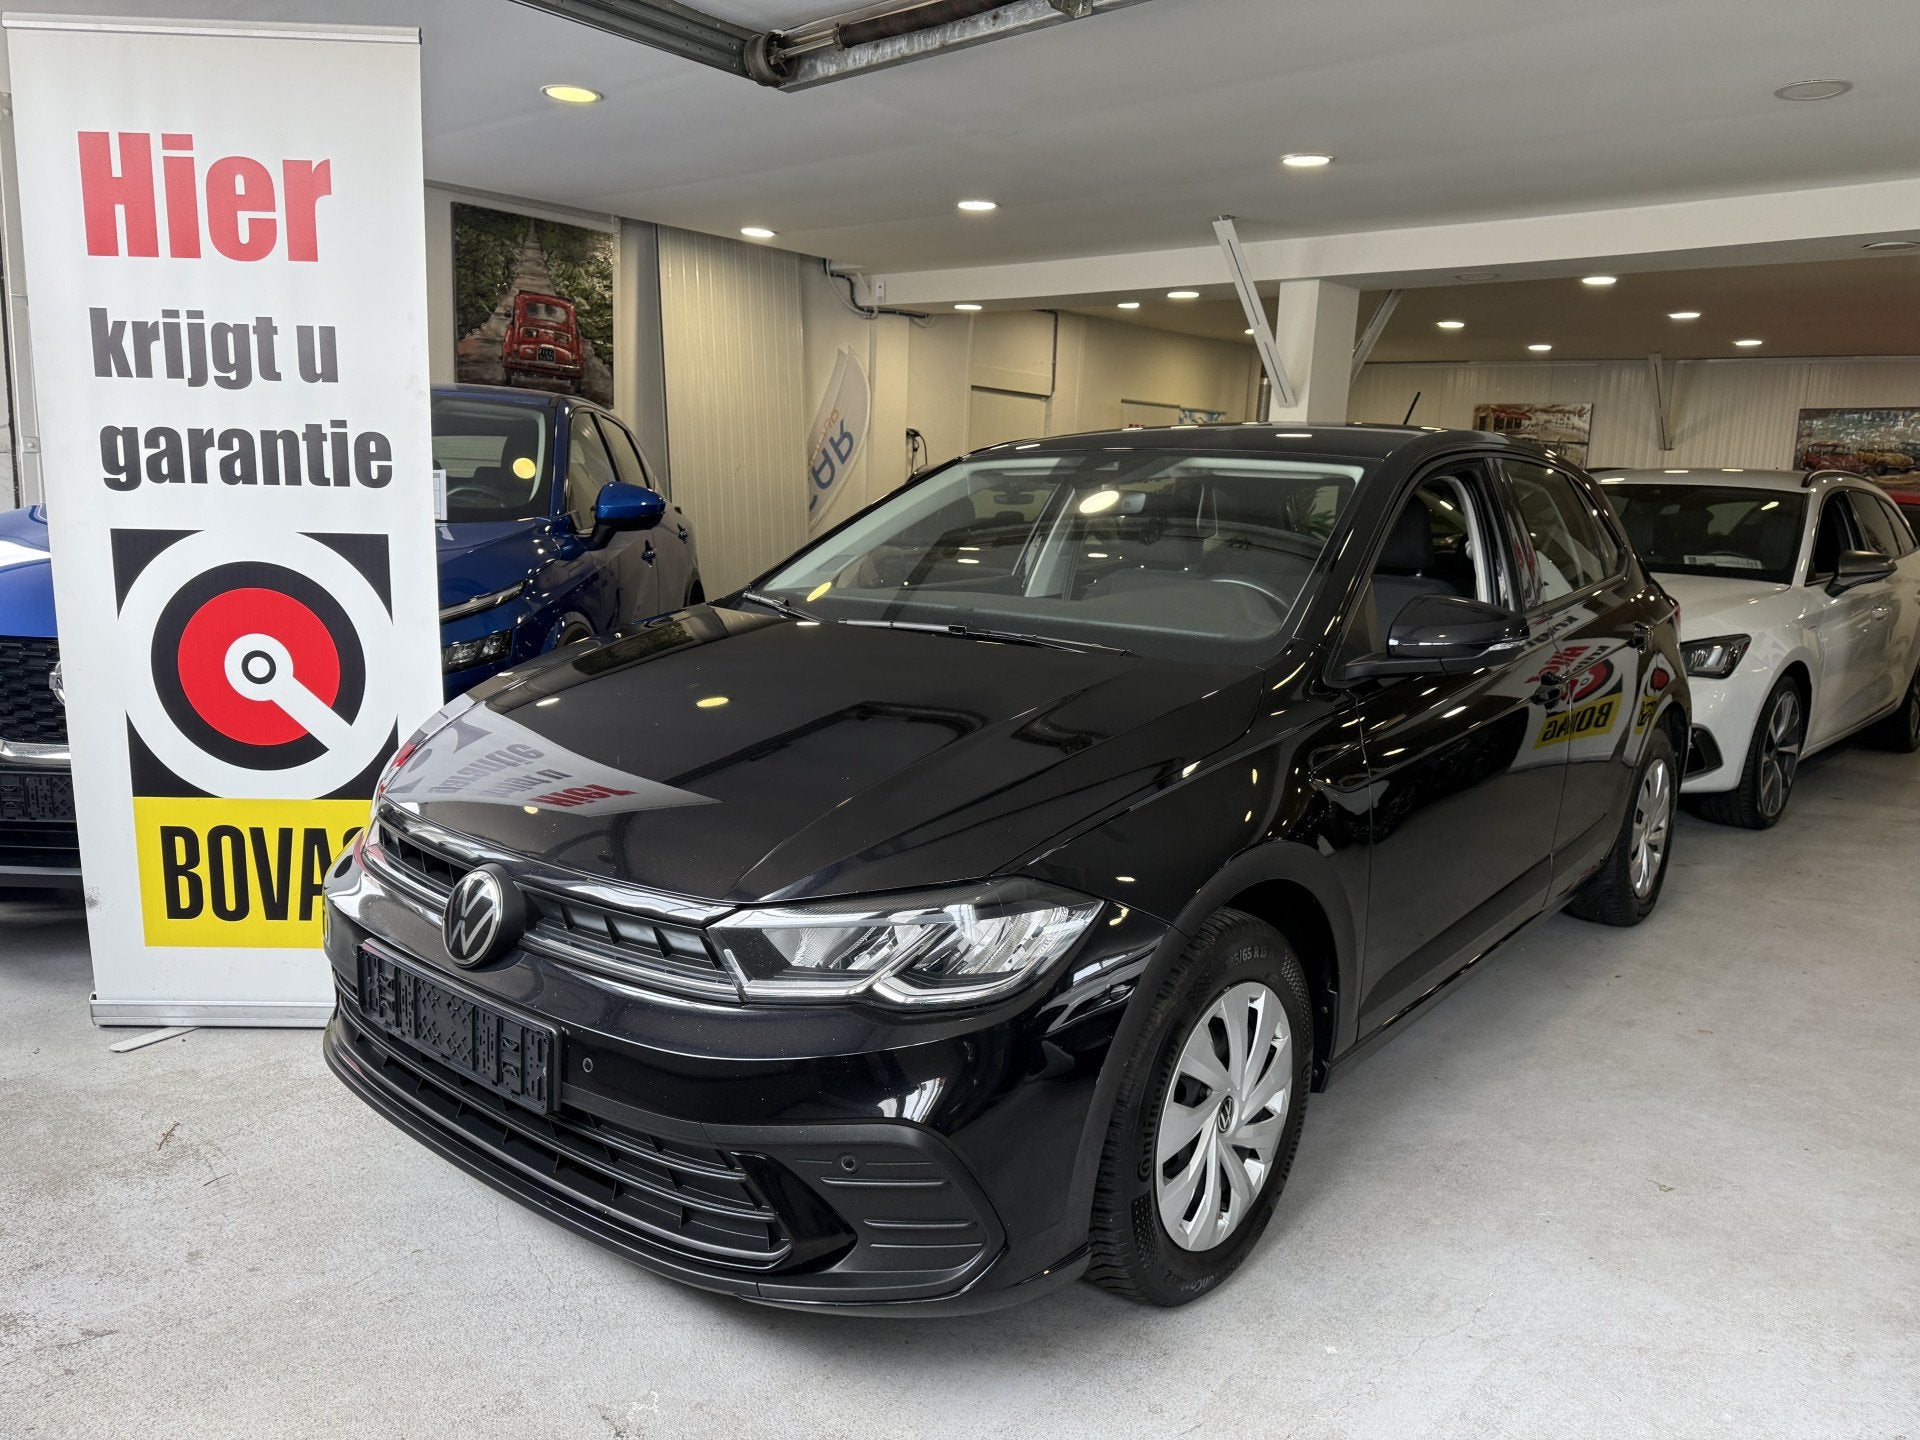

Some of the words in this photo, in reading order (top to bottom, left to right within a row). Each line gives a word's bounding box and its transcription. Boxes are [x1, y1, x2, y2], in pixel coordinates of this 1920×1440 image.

[77, 131, 332, 262] Hier
[89, 307, 282, 390] krijgt
[296, 325, 339, 384] u
[100, 420, 393, 492] garantie
[160, 824, 363, 922] BOVA
